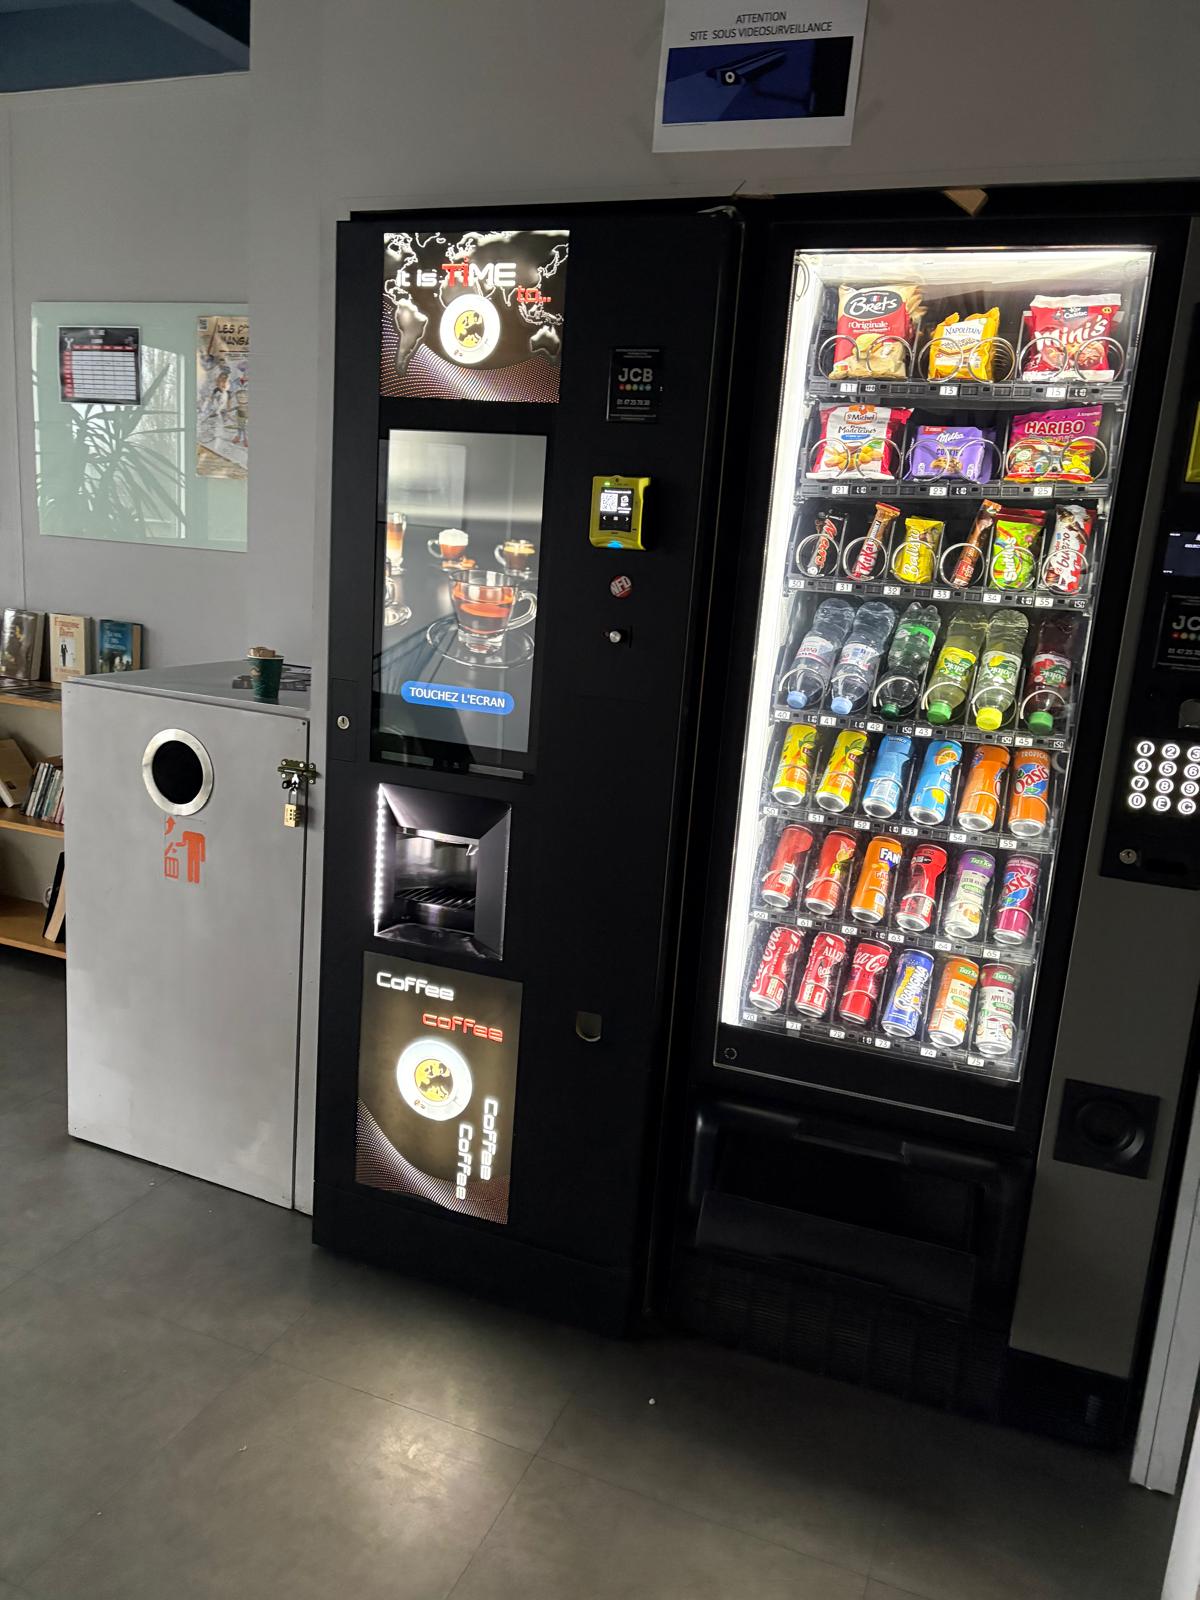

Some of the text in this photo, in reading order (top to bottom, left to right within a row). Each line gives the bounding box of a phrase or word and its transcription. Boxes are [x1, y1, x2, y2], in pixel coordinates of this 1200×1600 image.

[735, 11, 787, 24] ATTENTION
[690, 21, 833, 41] SITE SOUS VIDEOSURVEILLANCE
[618, 367, 653, 383] JCB
[1025, 420, 1085, 435] HARIBO
[409, 686, 506, 708] TOUCHEZ L'ECRAN
[376, 970, 455, 1002] Coffee
[480, 1097, 500, 1181] Coffee
[455, 1122, 474, 1200] Coffee
